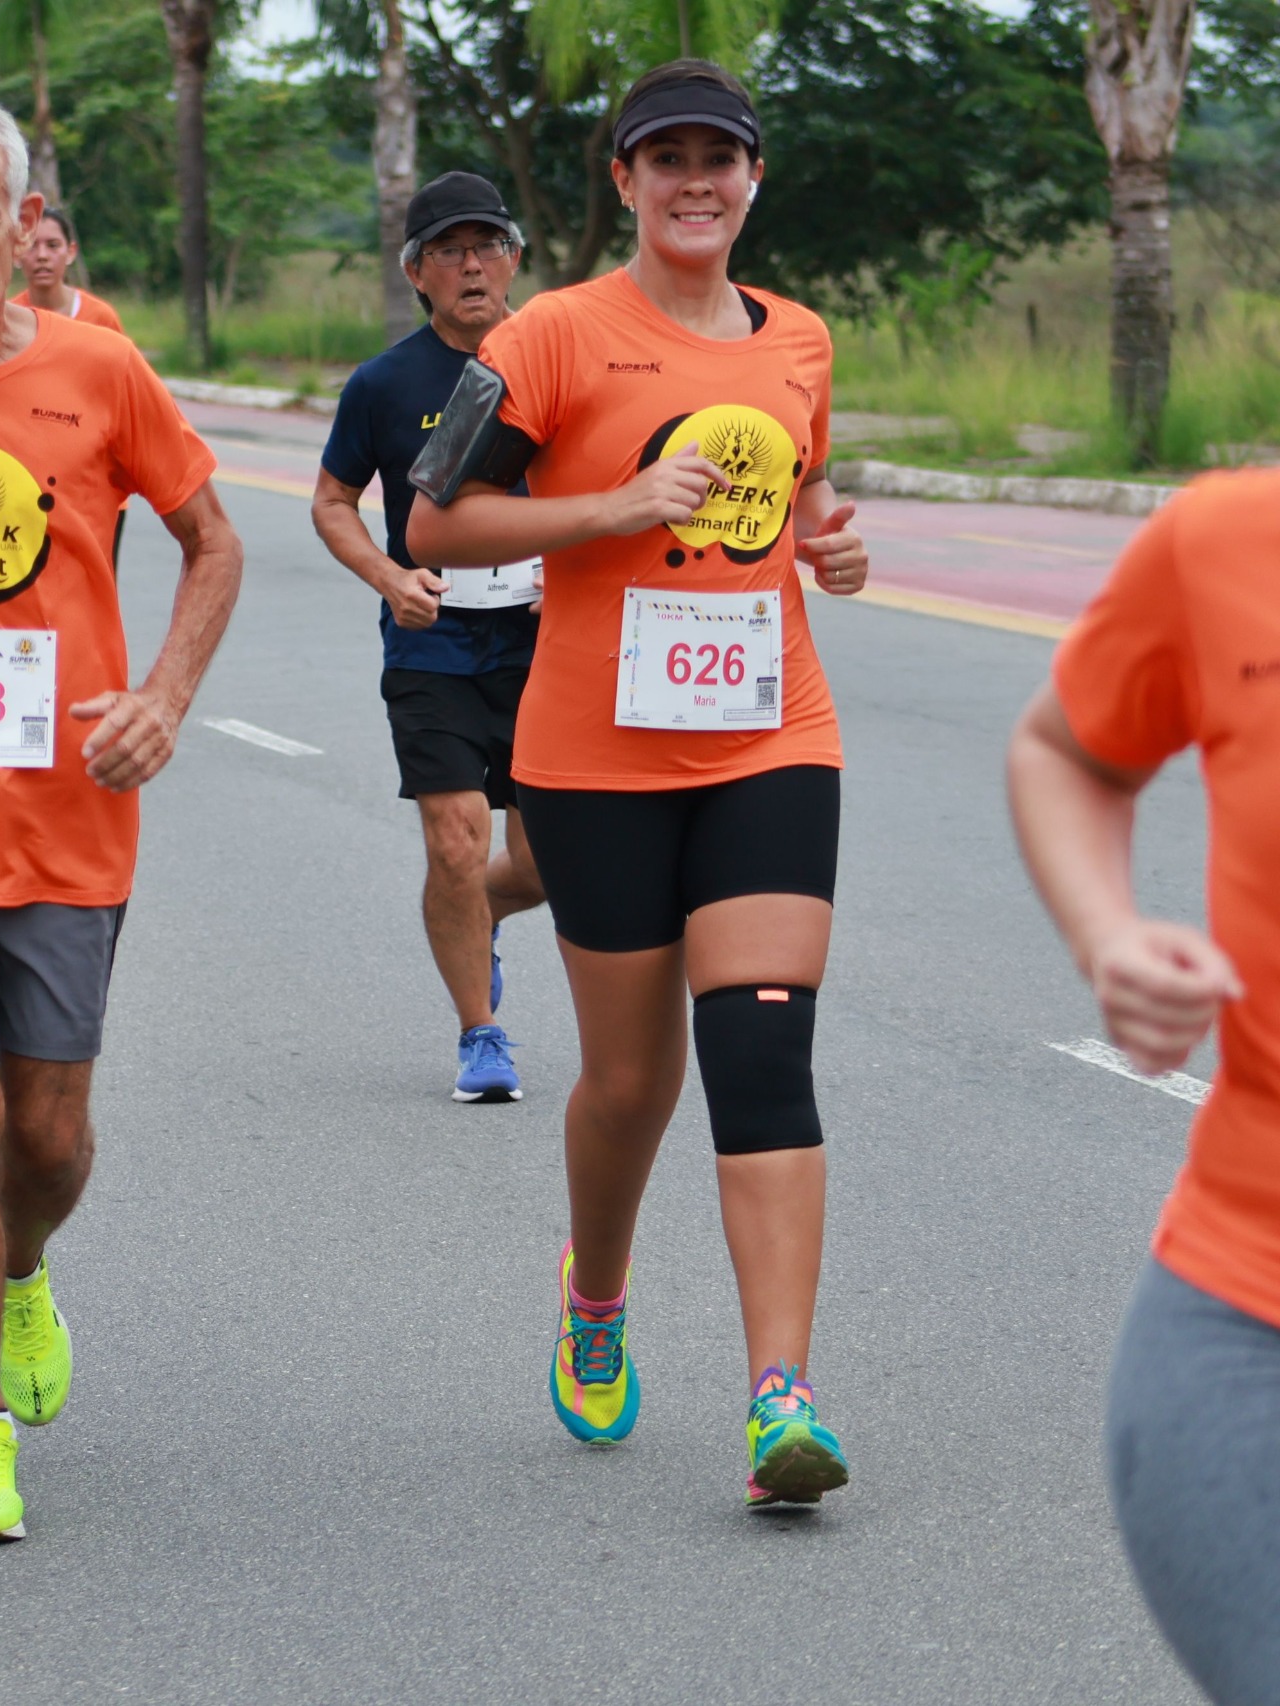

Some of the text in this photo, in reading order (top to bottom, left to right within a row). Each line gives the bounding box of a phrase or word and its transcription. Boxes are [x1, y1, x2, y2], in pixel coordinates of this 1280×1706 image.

[759, 489, 778, 507] K
[2, 525, 21, 543] K
[688, 515, 761, 537] smart fit
[487, 584, 509, 592] Alfredo
[656, 613, 684, 621] 10KM
[666, 642, 746, 686] 626
[693, 694, 716, 706] Maria
